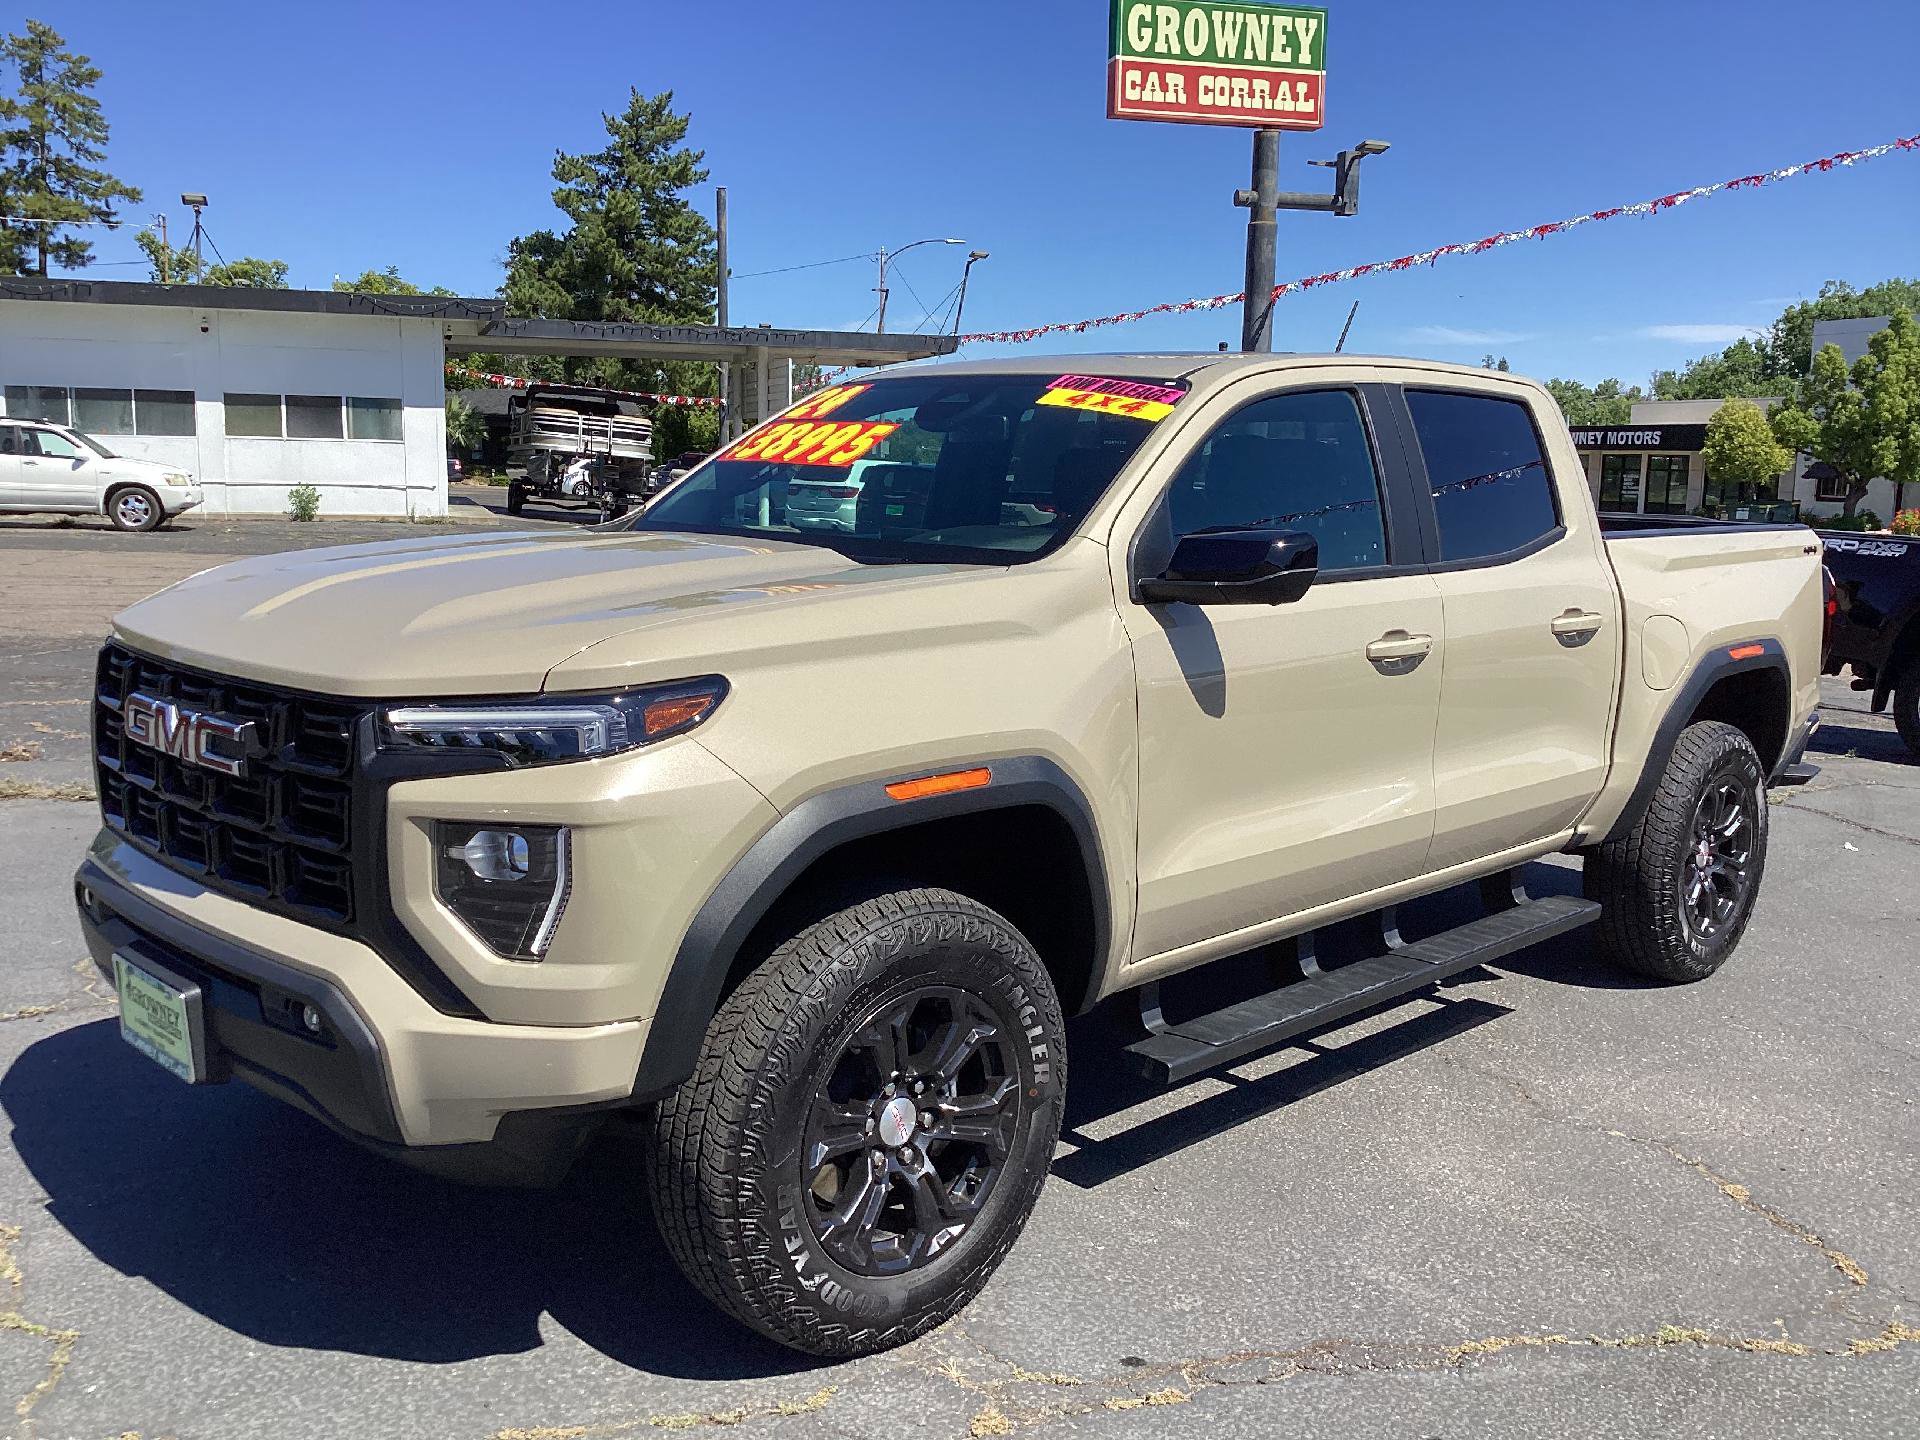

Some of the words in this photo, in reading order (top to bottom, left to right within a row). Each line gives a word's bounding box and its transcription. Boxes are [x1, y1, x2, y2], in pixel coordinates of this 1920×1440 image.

[1127, 3, 1318, 64] GROWNEY
[1125, 69, 1187, 104] CAR
[1198, 75, 1315, 113] CORRAL
[1607, 431, 1662, 445] MOTORS
[1821, 538, 1860, 552] RD
[124, 692, 244, 777] GMC
